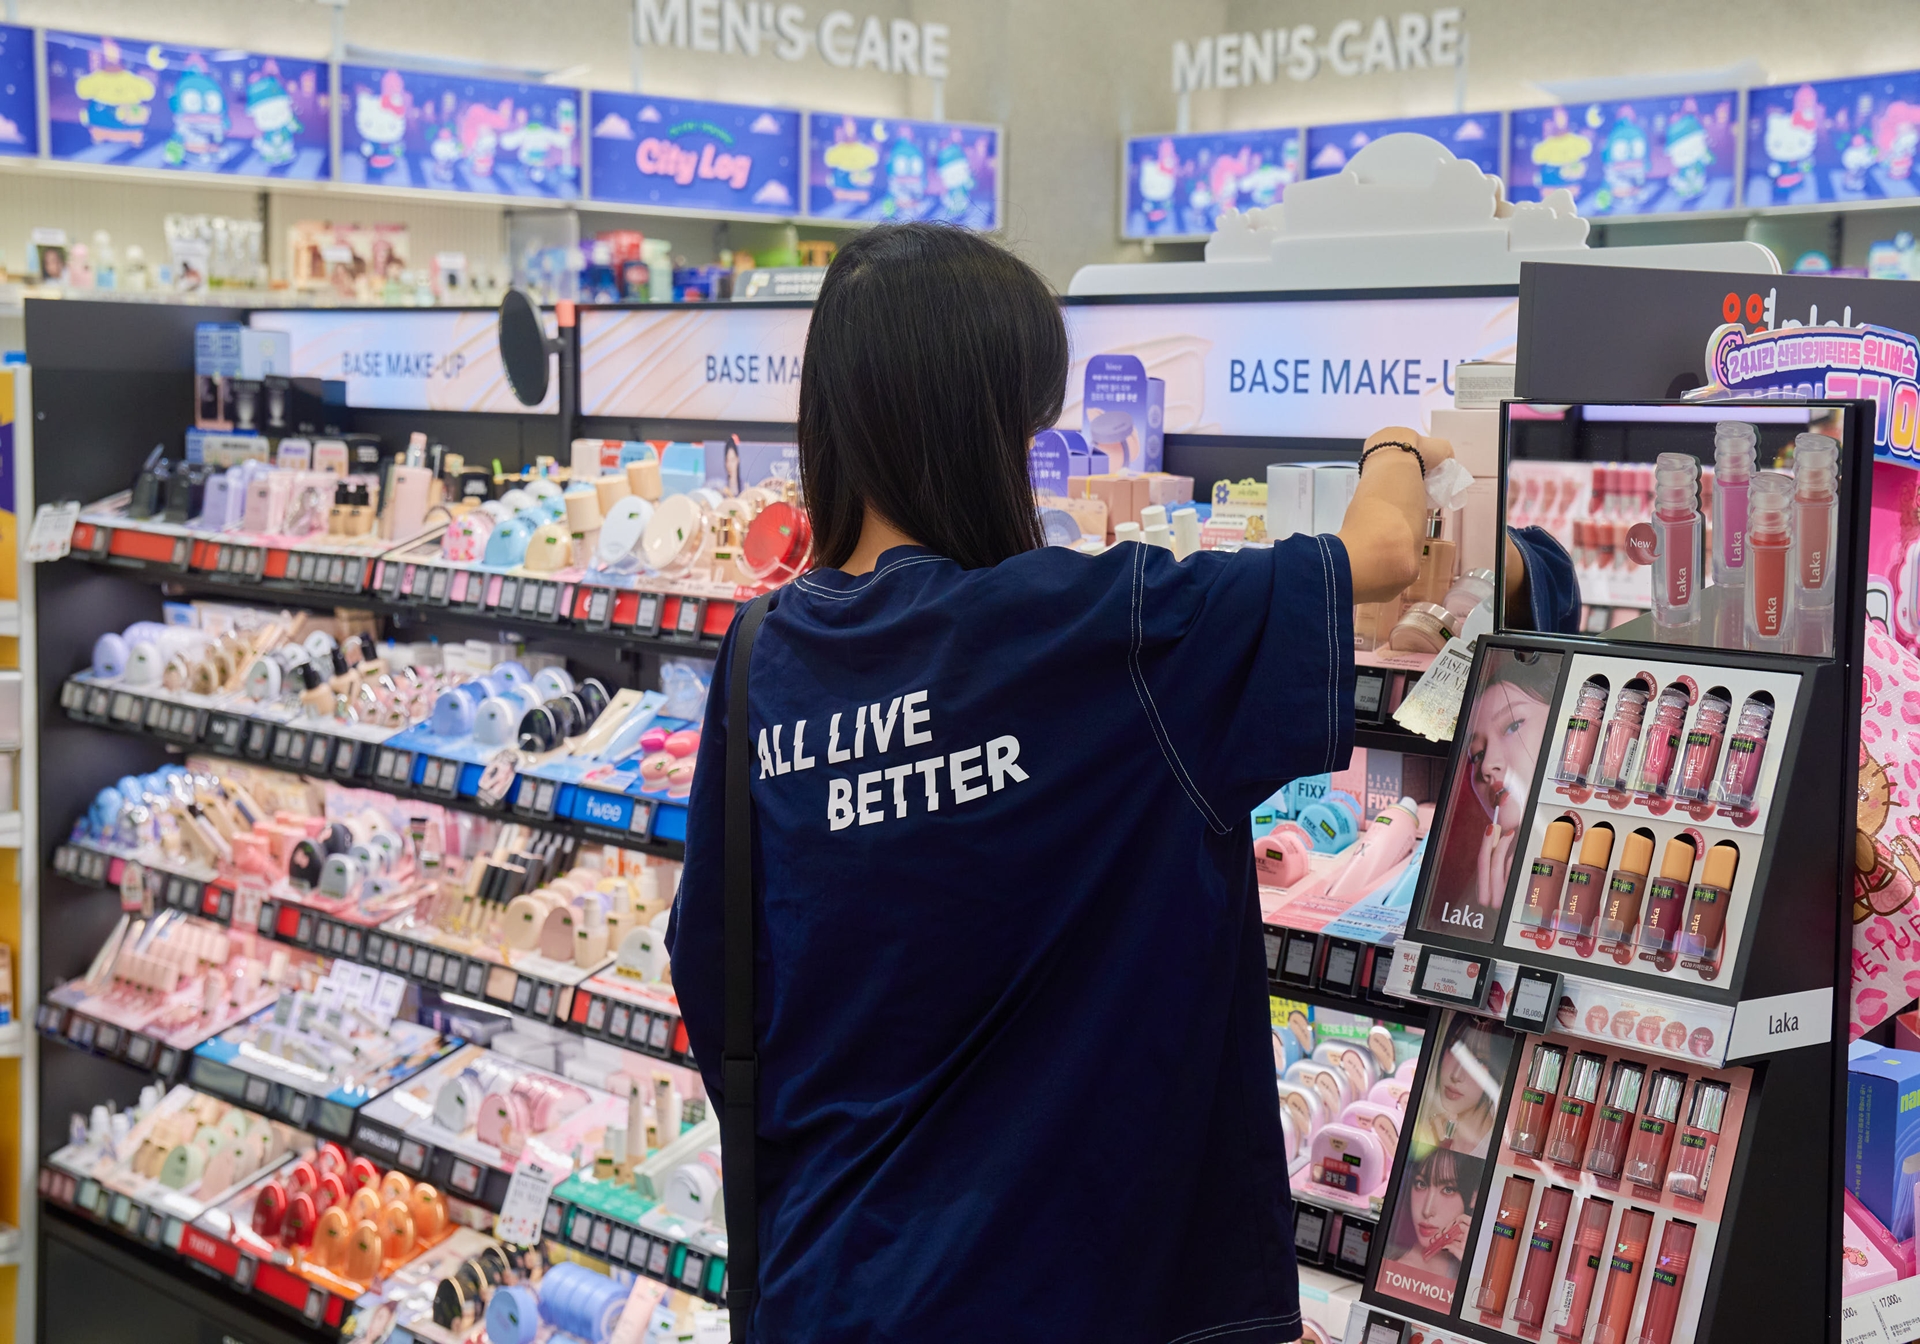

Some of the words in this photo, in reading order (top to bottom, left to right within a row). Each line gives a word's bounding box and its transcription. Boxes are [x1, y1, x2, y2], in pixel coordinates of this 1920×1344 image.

[635, 0, 806, 61] MEN'S
[817, 11, 949, 78] CARE
[1171, 31, 1314, 92] MEN'S
[1318, 8, 1465, 75] CARE
[636, 139, 698, 185] City
[698, 145, 752, 189] Log
[342, 352, 381, 378] BASE
[387, 353, 465, 379] MAKE-UP
[705, 355, 758, 384] BASE
[1730, 342, 1774, 380] 24시간
[1778, 338, 1861, 369] 산리오캐릭터즈
[1864, 338, 1917, 378] 유니버스
[1230, 359, 1310, 394] BASE
[1322, 359, 1484, 395] MAKE-U
[1630, 537, 1651, 549] New
[1732, 531, 1742, 562] Laka
[1810, 551, 1821, 583] Laka
[1677, 567, 1687, 599] Laka
[1765, 597, 1777, 630] Laka
[757, 720, 816, 780] ALL
[827, 690, 933, 764] LIVE
[827, 734, 1030, 831] BETTER
[1298, 782, 1326, 798] FIXX
[1530, 887, 1540, 908] Laka
[1568, 895, 1578, 916] Laka
[1610, 900, 1619, 922] Laka
[1441, 902, 1484, 930] Laka
[1649, 907, 1660, 929] Laka
[1690, 914, 1701, 936] Laka
[1768, 1012, 1799, 1035] Laka
[1385, 1271, 1454, 1304] TONYMOLY
